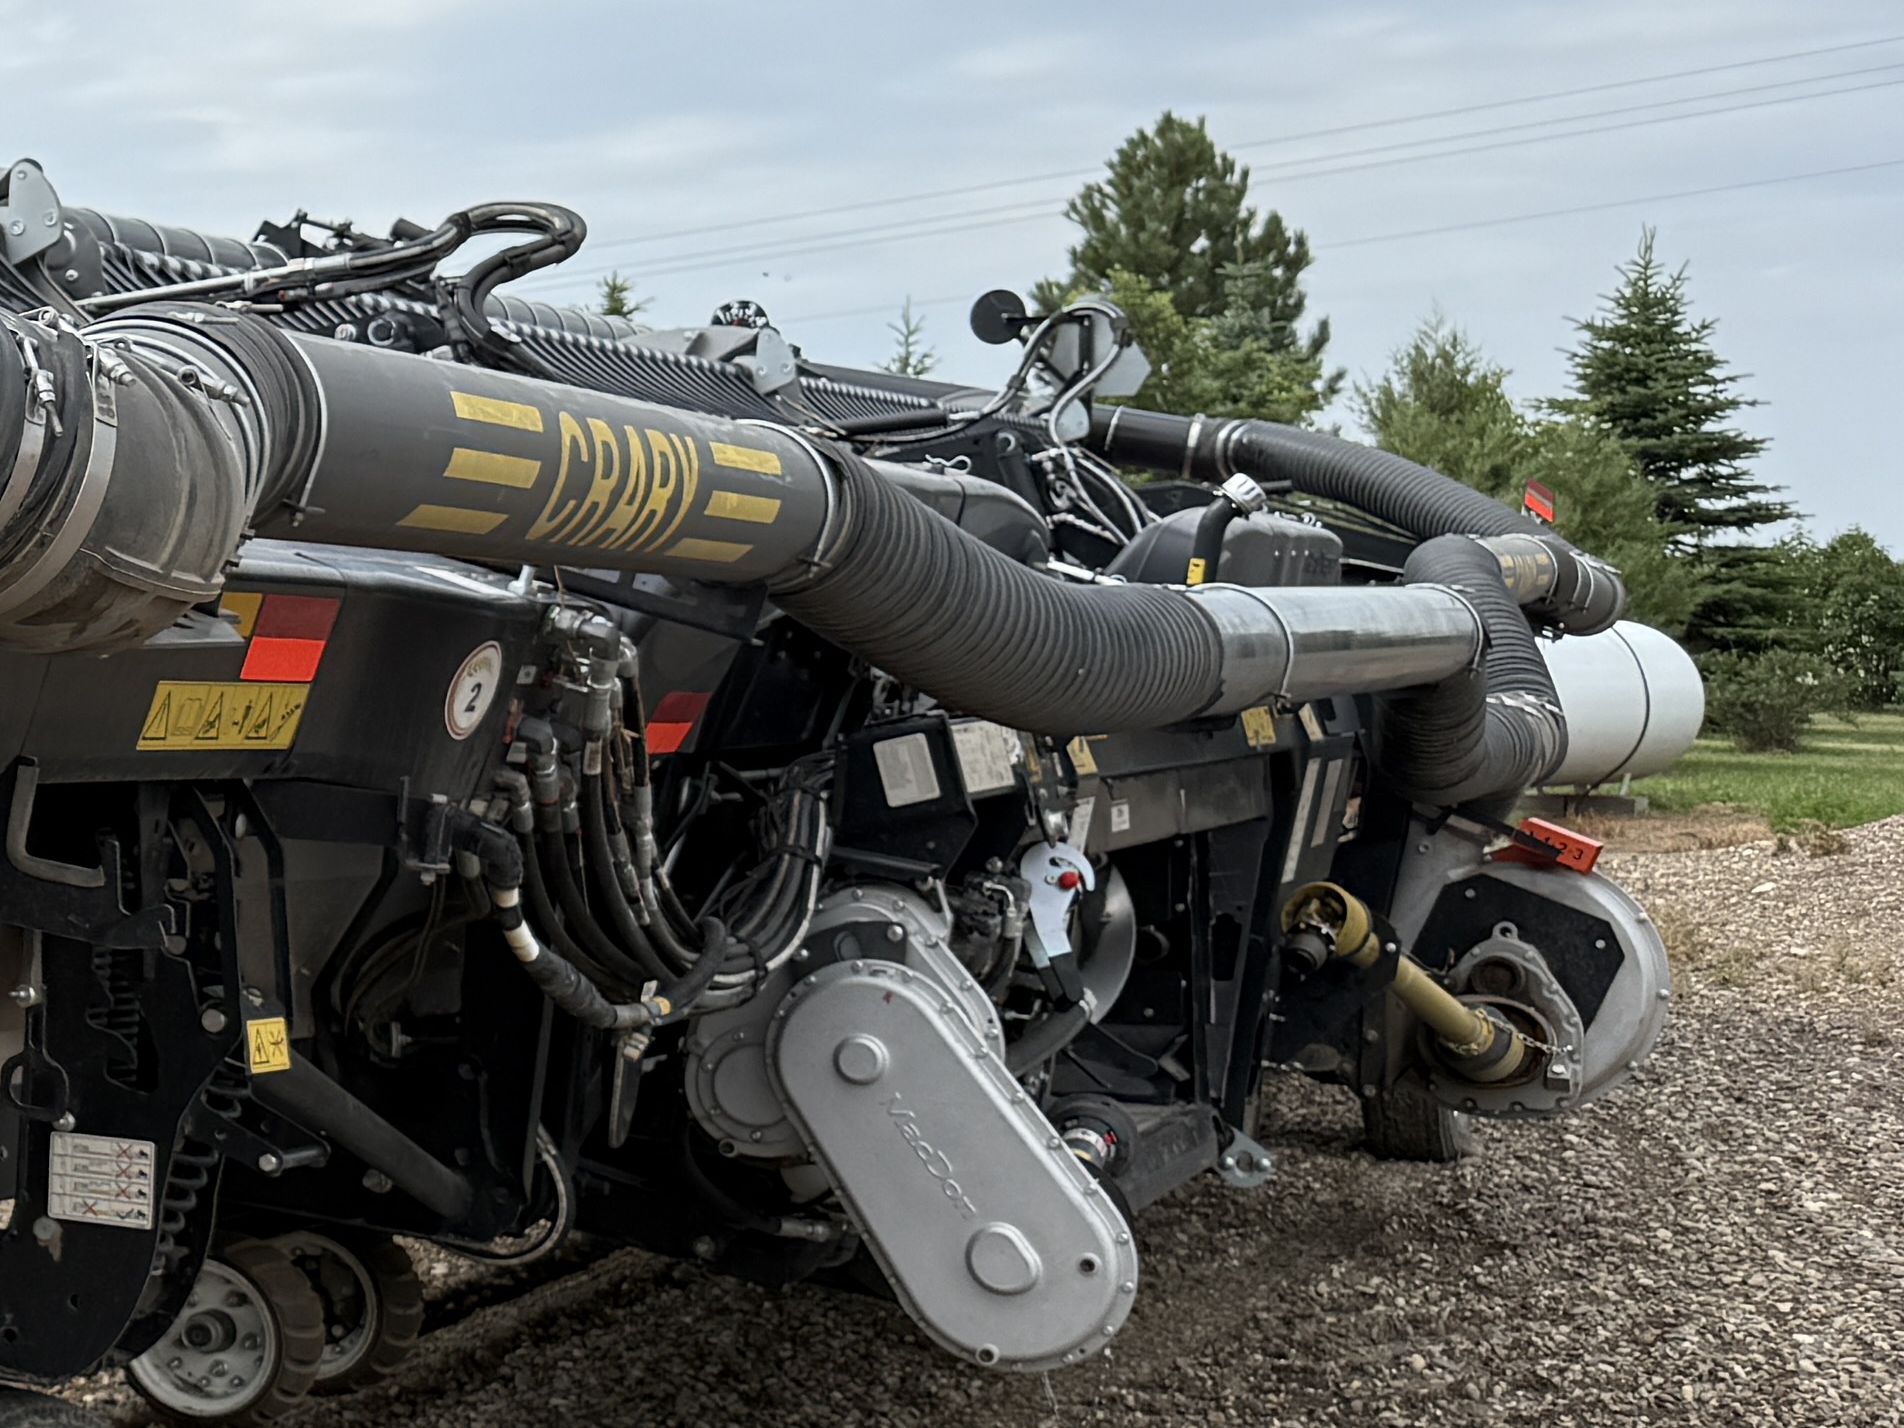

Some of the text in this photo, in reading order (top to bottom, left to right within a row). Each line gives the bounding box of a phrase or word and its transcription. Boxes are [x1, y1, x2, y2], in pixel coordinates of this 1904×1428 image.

[525, 411, 699, 553] CRARY
[464, 682, 482, 713] 2
[878, 1092, 978, 1220] MacDon
